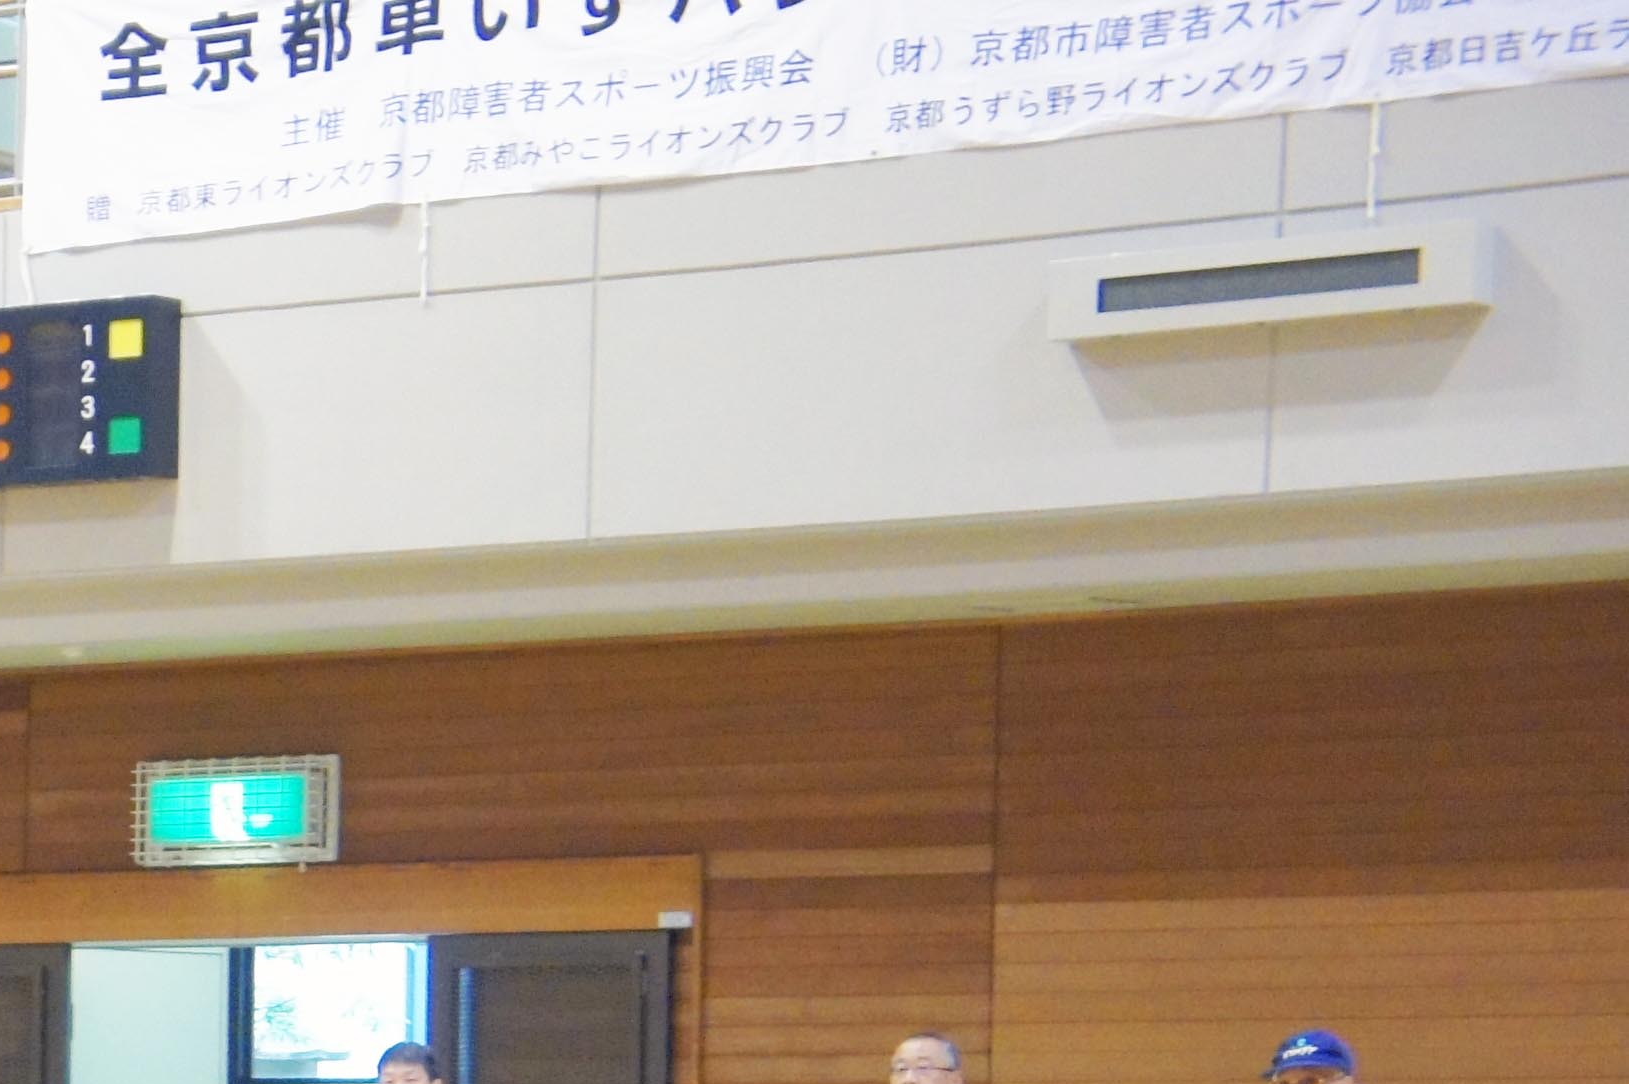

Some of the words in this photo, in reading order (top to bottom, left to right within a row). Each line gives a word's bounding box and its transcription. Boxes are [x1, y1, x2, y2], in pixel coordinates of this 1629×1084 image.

[137, 149, 434, 216] 京都東ライオンズクラブ
[464, 106, 851, 173] 京都みやこライオンズクラブ
[884, 48, 1349, 134] 京都うずら野ライオンズクラブ
[281, 106, 348, 147] 主催
[82, 324, 93, 347] 1
[81, 359, 96, 383] 2
[80, 395, 96, 419] 3
[79, 431, 96, 455] 4
